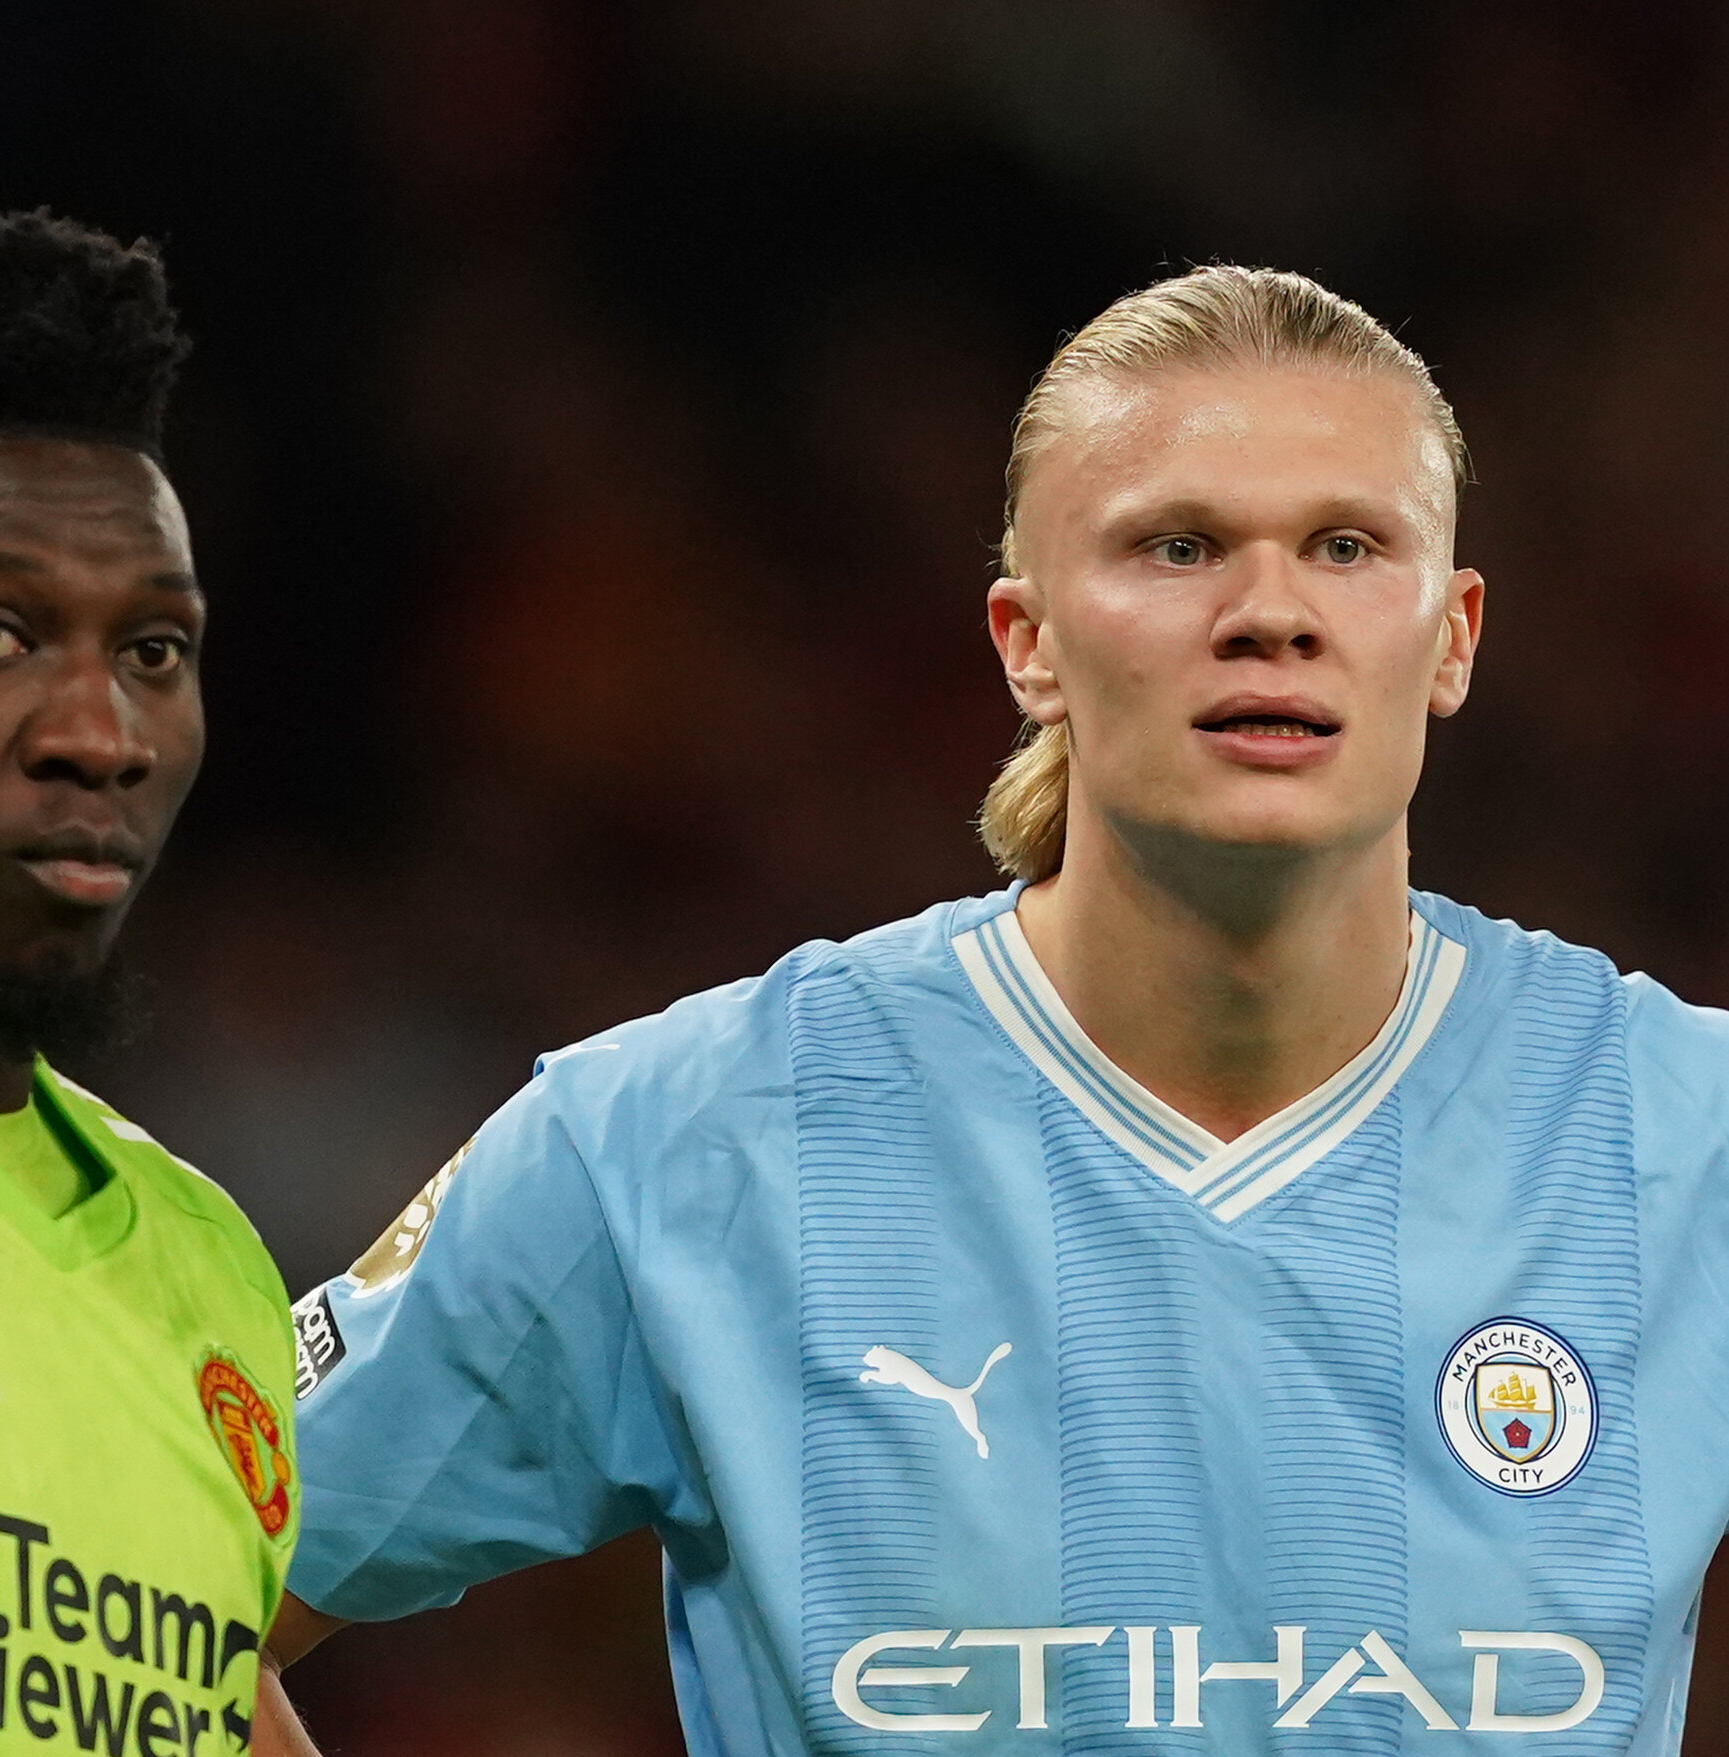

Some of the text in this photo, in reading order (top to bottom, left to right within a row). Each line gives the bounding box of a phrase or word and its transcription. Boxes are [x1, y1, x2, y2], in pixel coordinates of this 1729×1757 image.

[1452, 1331, 1577, 1387] MANCHESTER
[1498, 1468, 1544, 1484] CITY
[831, 1625, 1606, 1732] ETIHAD
